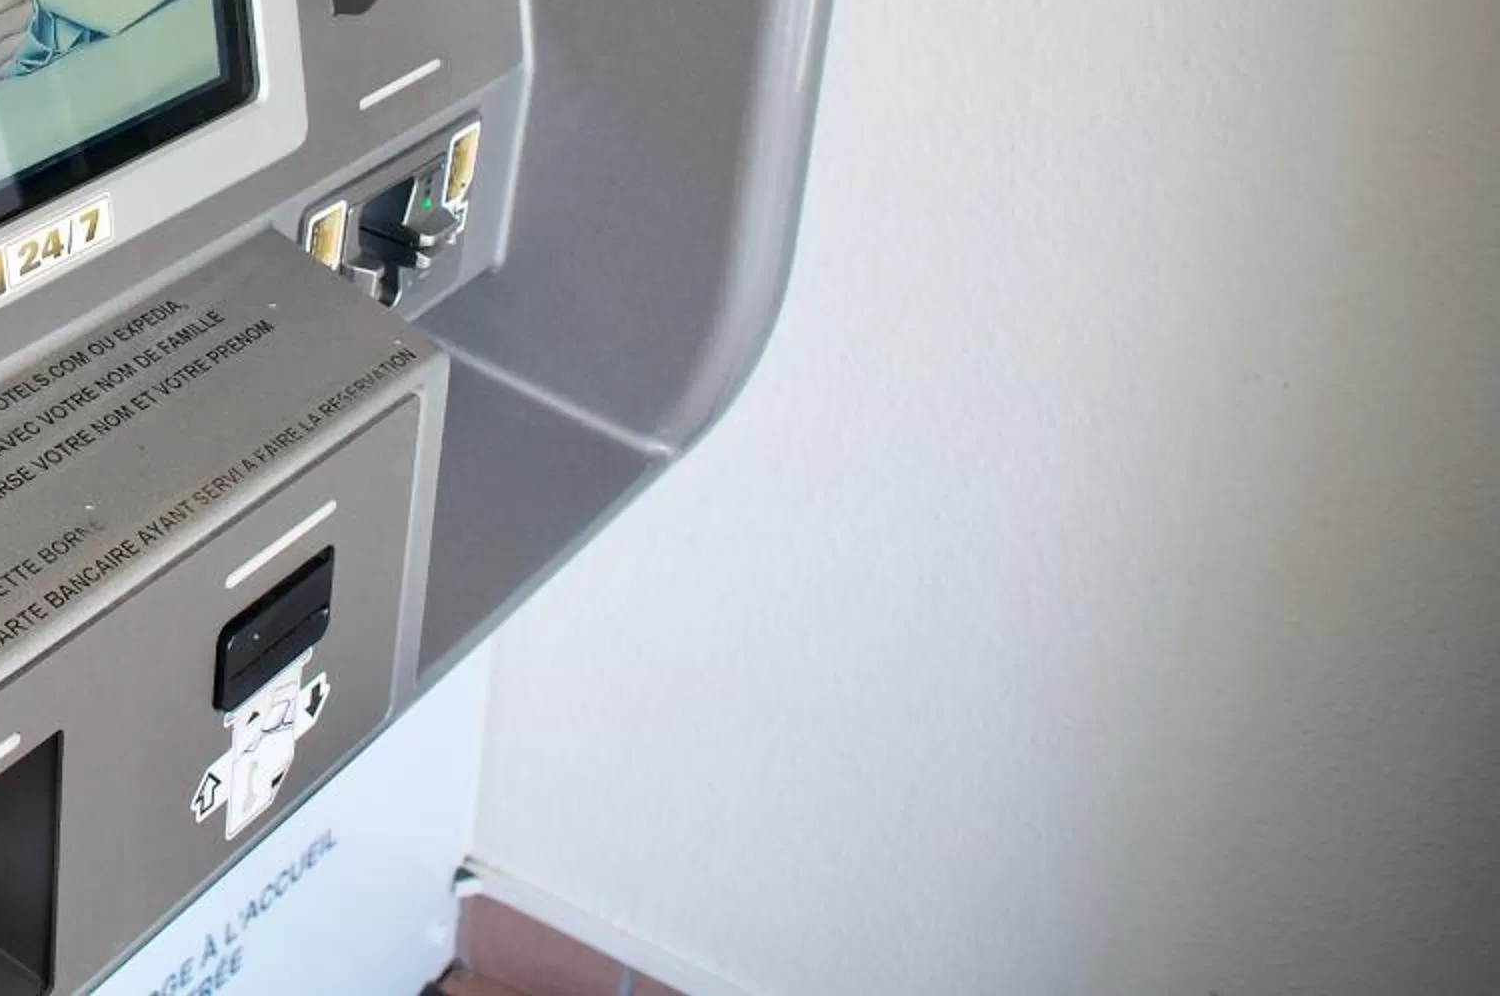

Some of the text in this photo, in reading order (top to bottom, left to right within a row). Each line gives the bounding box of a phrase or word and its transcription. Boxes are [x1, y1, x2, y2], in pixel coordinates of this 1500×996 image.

[36, 386, 101, 436] VOTRE
[94, 362, 140, 395] NOM
[132, 347, 163, 370] DE
[155, 308, 226, 356] FAMILLE
[86, 334, 116, 358] OU
[31, 427, 101, 475] VOTRE
[94, 403, 142, 437] NOM
[130, 389, 156, 415] ET
[151, 358, 213, 395] VOTRE
[205, 318, 275, 365] PRENOM
[37, 521, 107, 565] BOR
[44, 538, 141, 610] BANCAIRE
[138, 499, 198, 547] AYANT
[191, 467, 243, 506] SERVI
[240, 457, 258, 474] A
[251, 426, 303, 463] FAIRE
[298, 412, 322, 433] LA
[148, 955, 195, 996] GE
